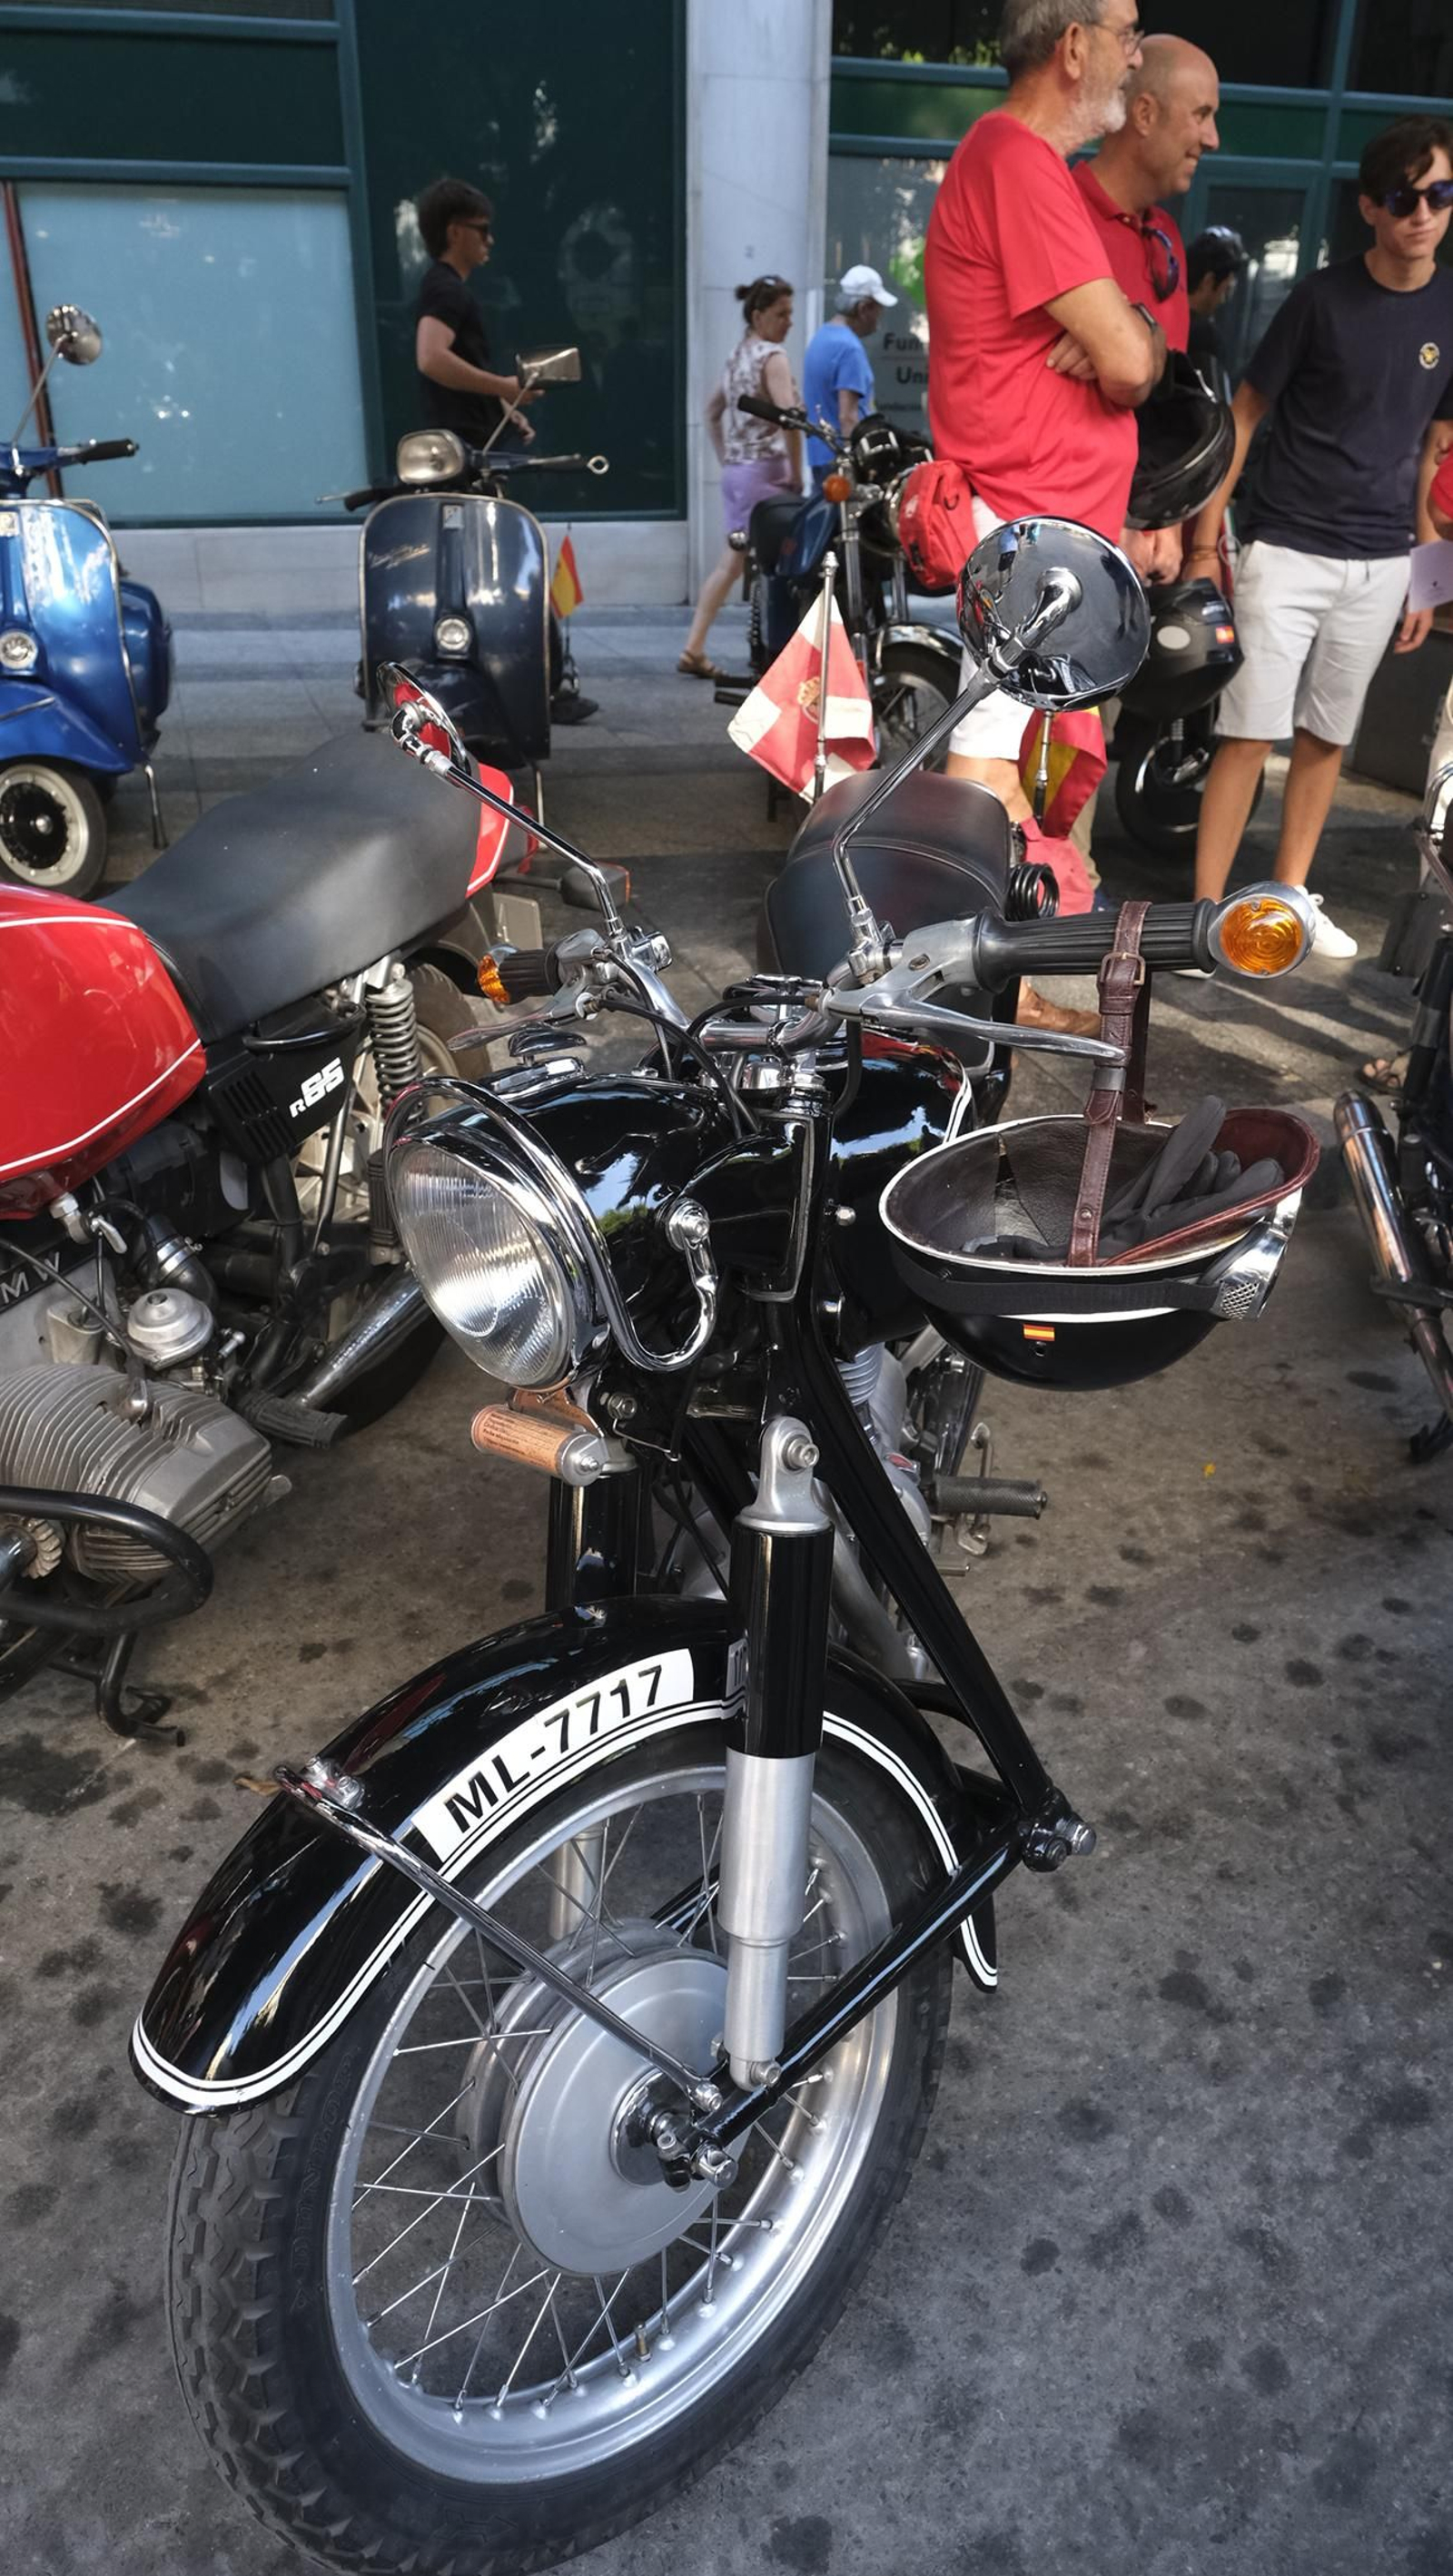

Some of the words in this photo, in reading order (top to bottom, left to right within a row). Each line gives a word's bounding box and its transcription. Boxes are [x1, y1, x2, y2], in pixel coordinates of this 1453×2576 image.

[884, 332, 922, 351] Fun
[289, 1057, 344, 1118] R65
[443, 1664, 662, 1833] ML-7717
